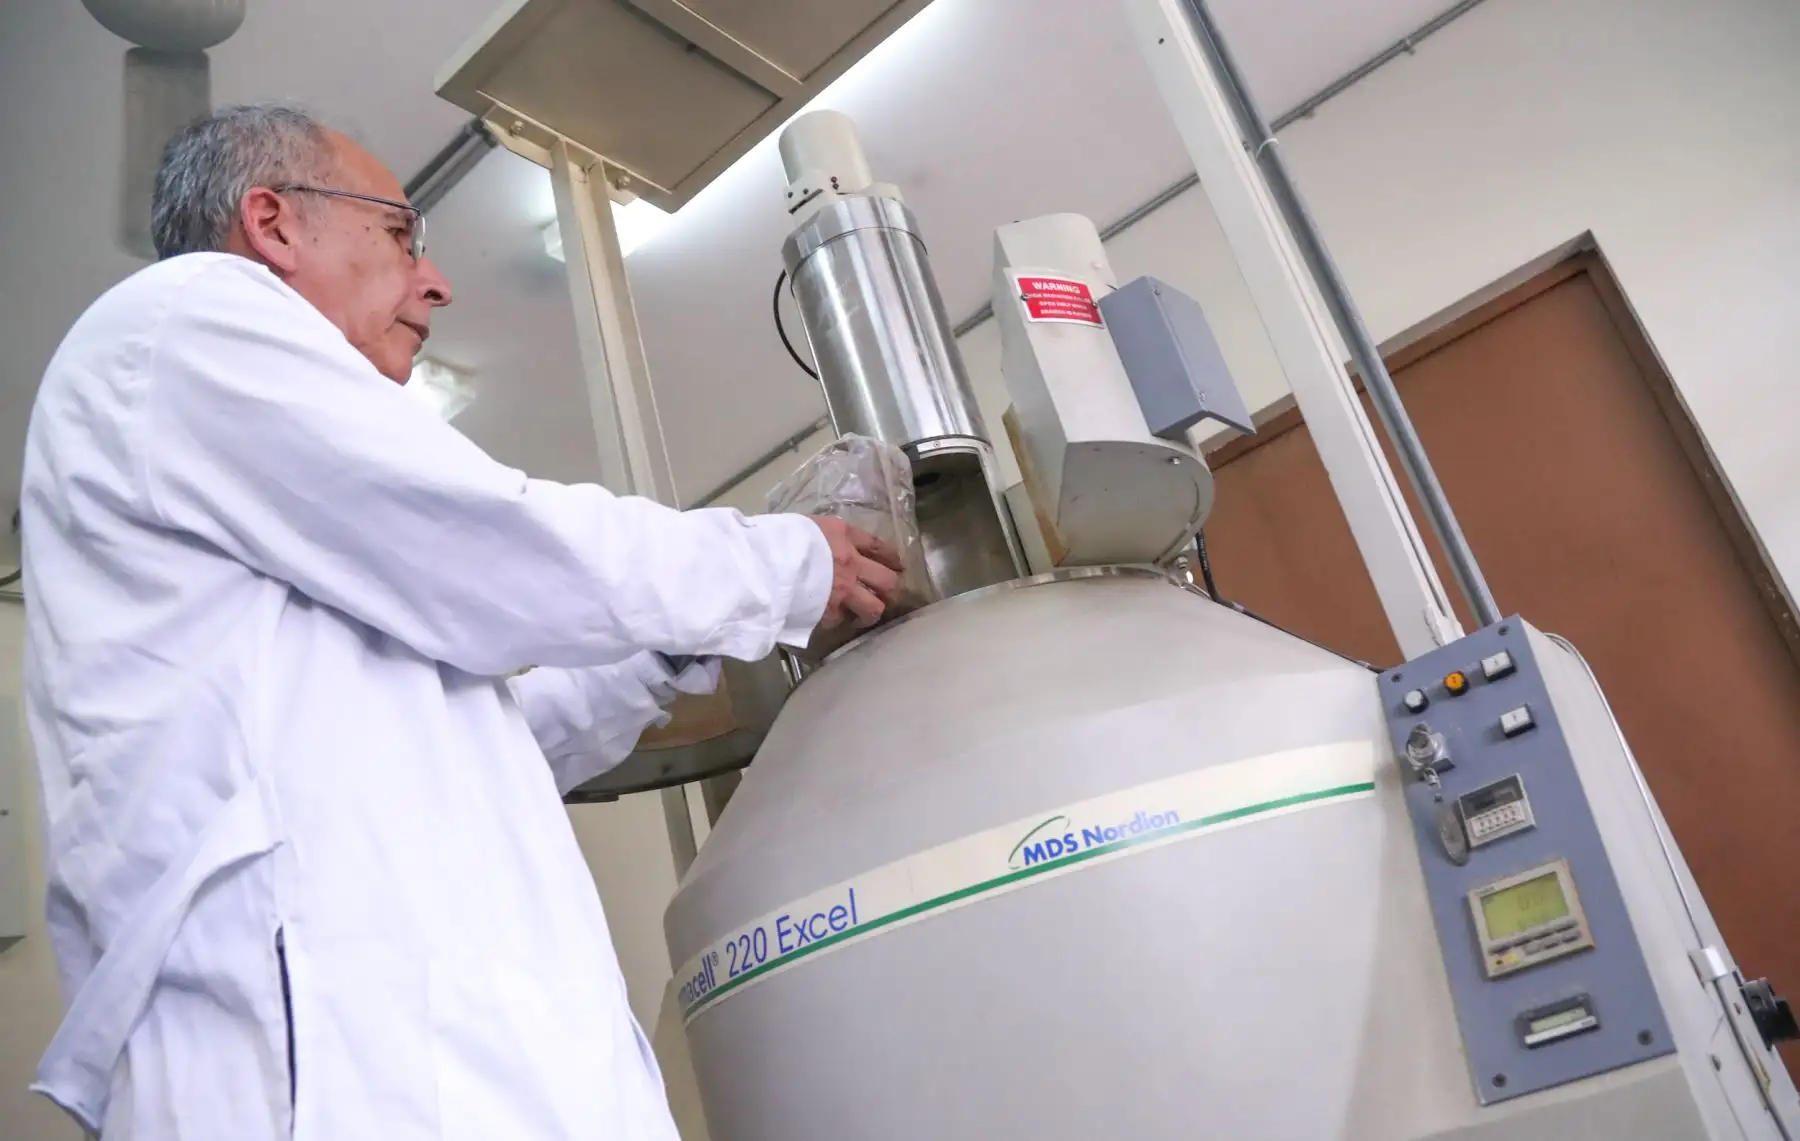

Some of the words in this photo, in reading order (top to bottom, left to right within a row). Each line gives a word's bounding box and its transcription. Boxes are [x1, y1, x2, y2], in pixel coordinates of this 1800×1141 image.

[1031, 281, 1081, 294] WARNING
[1022, 832, 1079, 866] MDS
[1081, 809, 1181, 848] Nordion
[726, 927, 768, 978] 220
[775, 887, 858, 954] Excel
